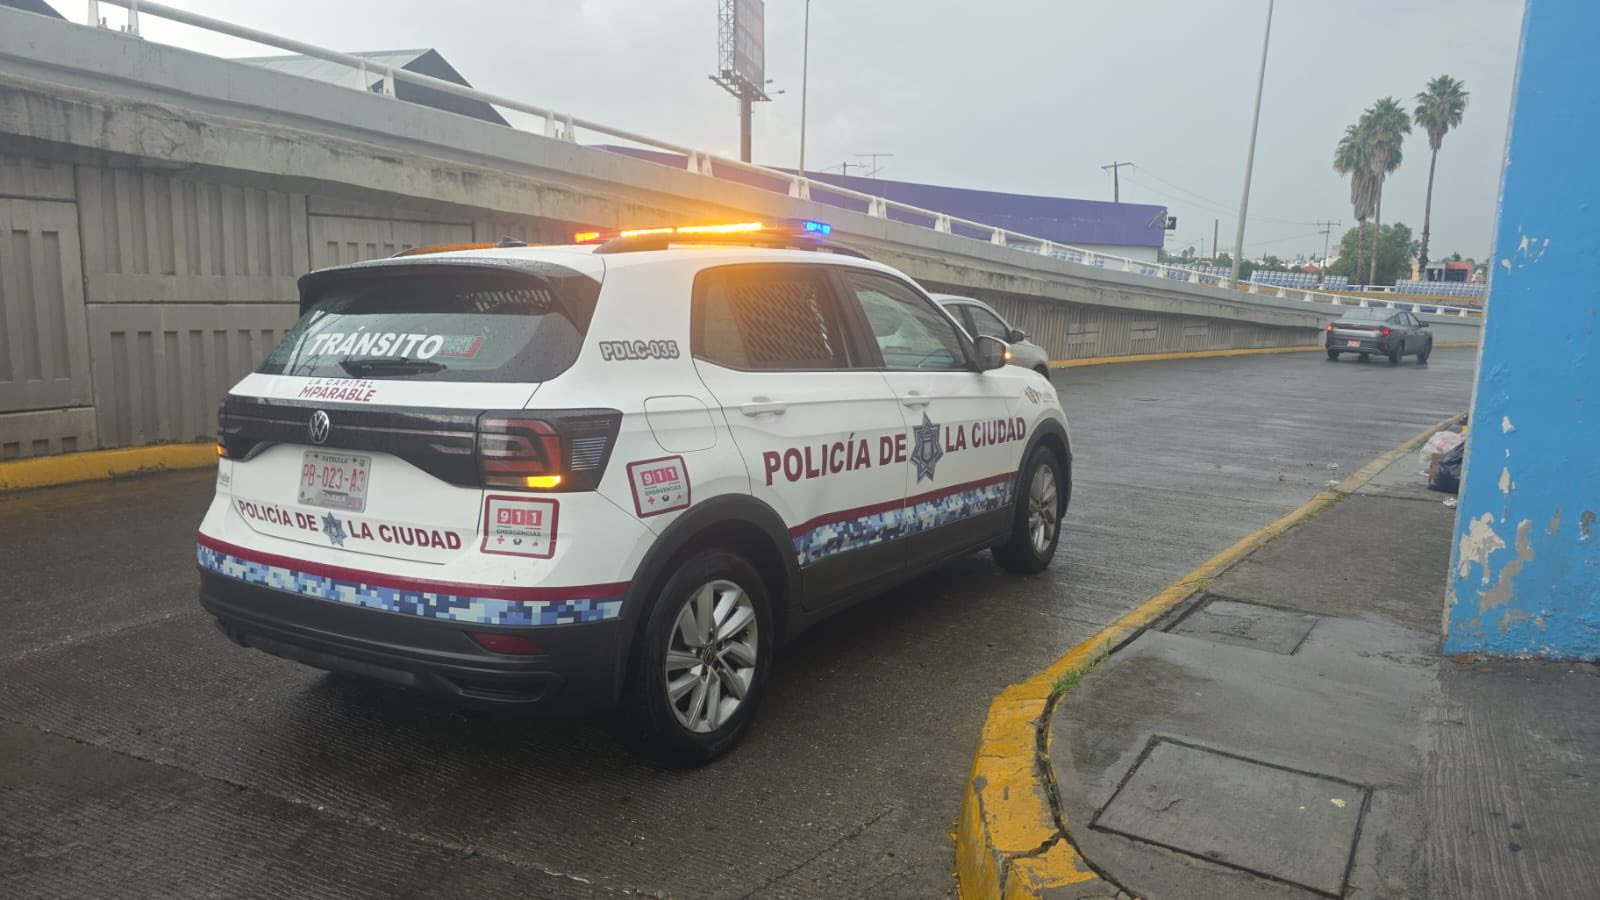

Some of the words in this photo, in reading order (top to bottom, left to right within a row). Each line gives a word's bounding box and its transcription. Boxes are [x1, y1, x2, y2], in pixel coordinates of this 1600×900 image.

[307, 326, 444, 360] TRÁNSITO
[599, 340, 680, 361] PDLC-035
[298, 386, 376, 402] MPARABLE
[763, 432, 871, 486] POLICÍA
[879, 434, 907, 466] DE
[945, 425, 967, 453] LA
[971, 417, 1026, 448] CIUDAD
[641, 467, 678, 486] 911
[645, 485, 682, 497] EMERGENCIAS
[237, 500, 293, 527] POLICÍA
[296, 512, 319, 532] DE
[347, 520, 375, 541] LA
[378, 525, 462, 550] CIUDAD
[498, 508, 541, 525] 911
[496, 529, 542, 537] EMERGENCIAS
